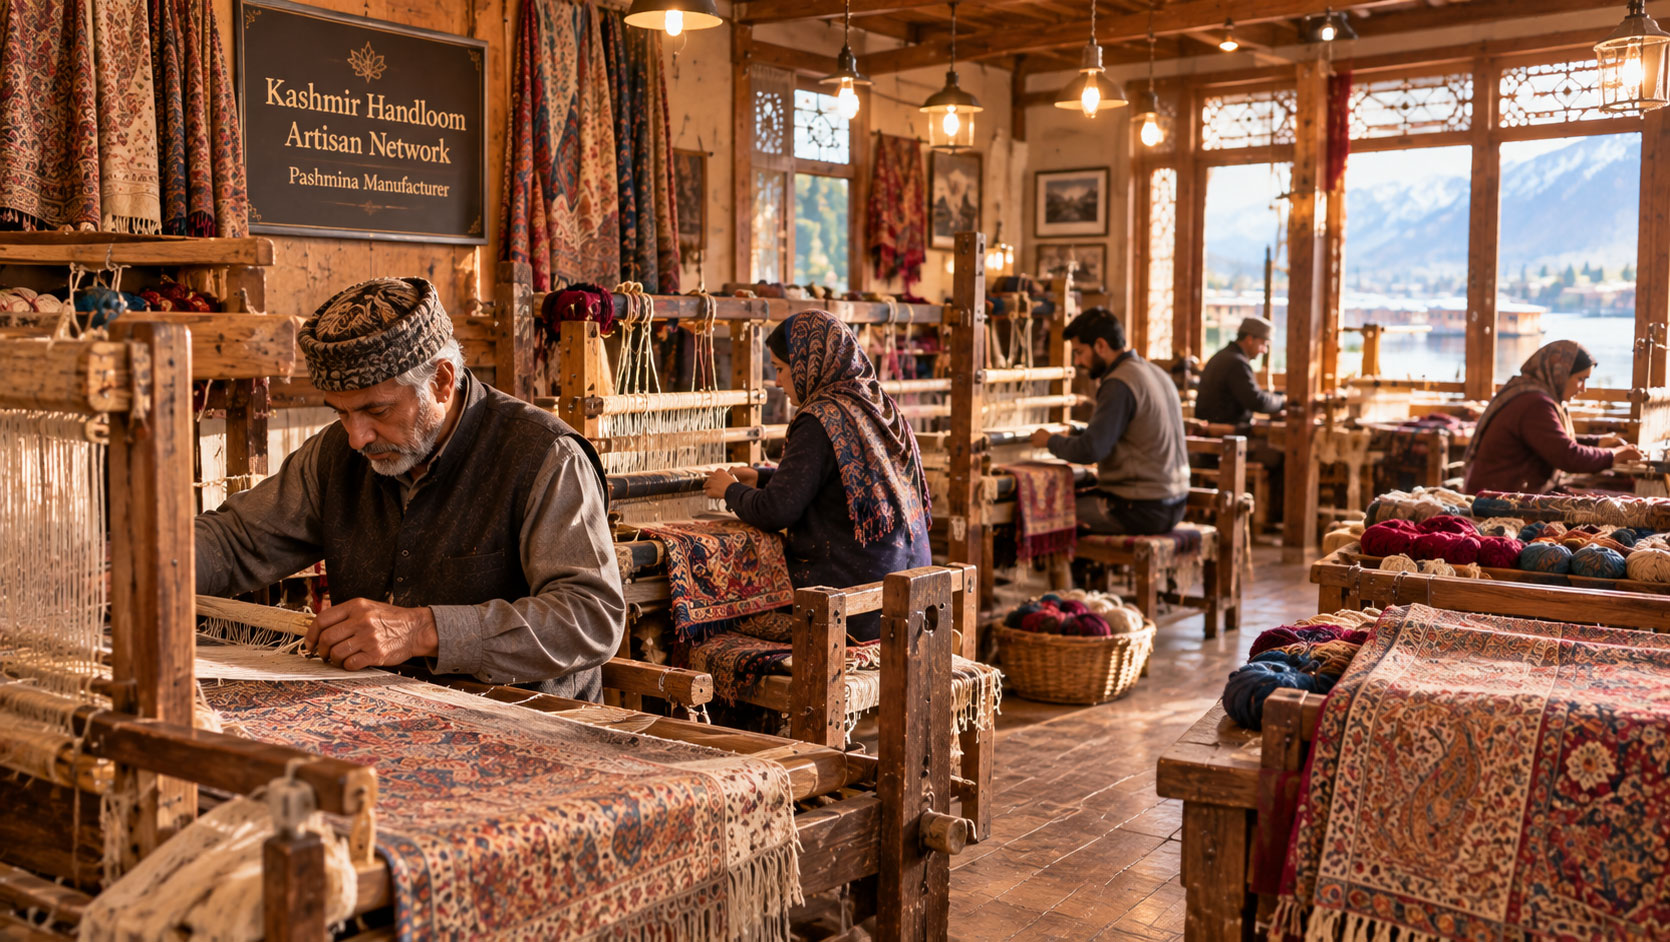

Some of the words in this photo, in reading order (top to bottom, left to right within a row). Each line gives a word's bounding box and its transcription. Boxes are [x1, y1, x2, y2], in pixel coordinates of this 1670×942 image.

[265, 77, 361, 117] Kashmir
[366, 93, 467, 131] Handloom
[284, 121, 363, 155] Artisan
[369, 131, 451, 164] Network
[288, 166, 359, 190] Pashmina
[363, 173, 450, 197] Manufacturer
